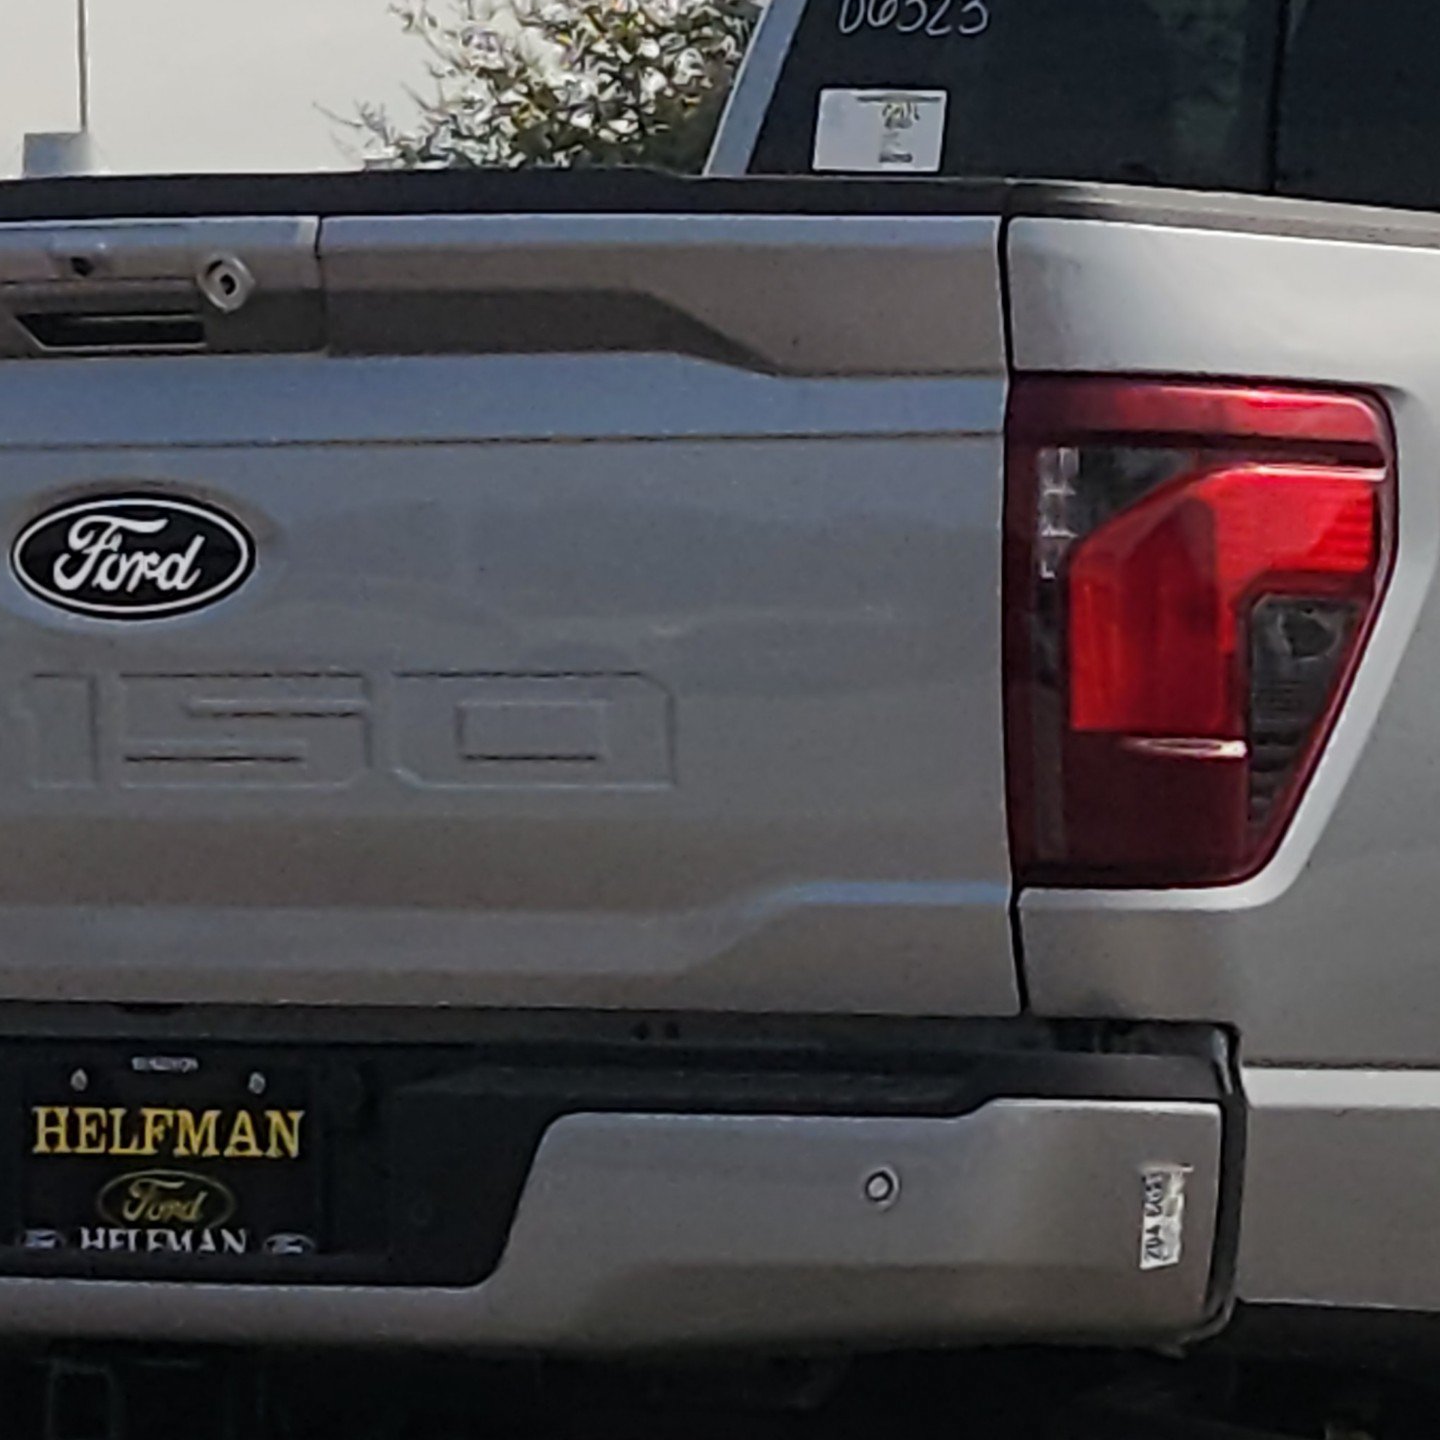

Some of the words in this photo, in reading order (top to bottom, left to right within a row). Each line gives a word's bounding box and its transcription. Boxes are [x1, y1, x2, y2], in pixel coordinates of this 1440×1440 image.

[53, 514, 205, 592] Ford
[31, 1105, 305, 1158] HELFMAN
[122, 1177, 208, 1222] Ford
